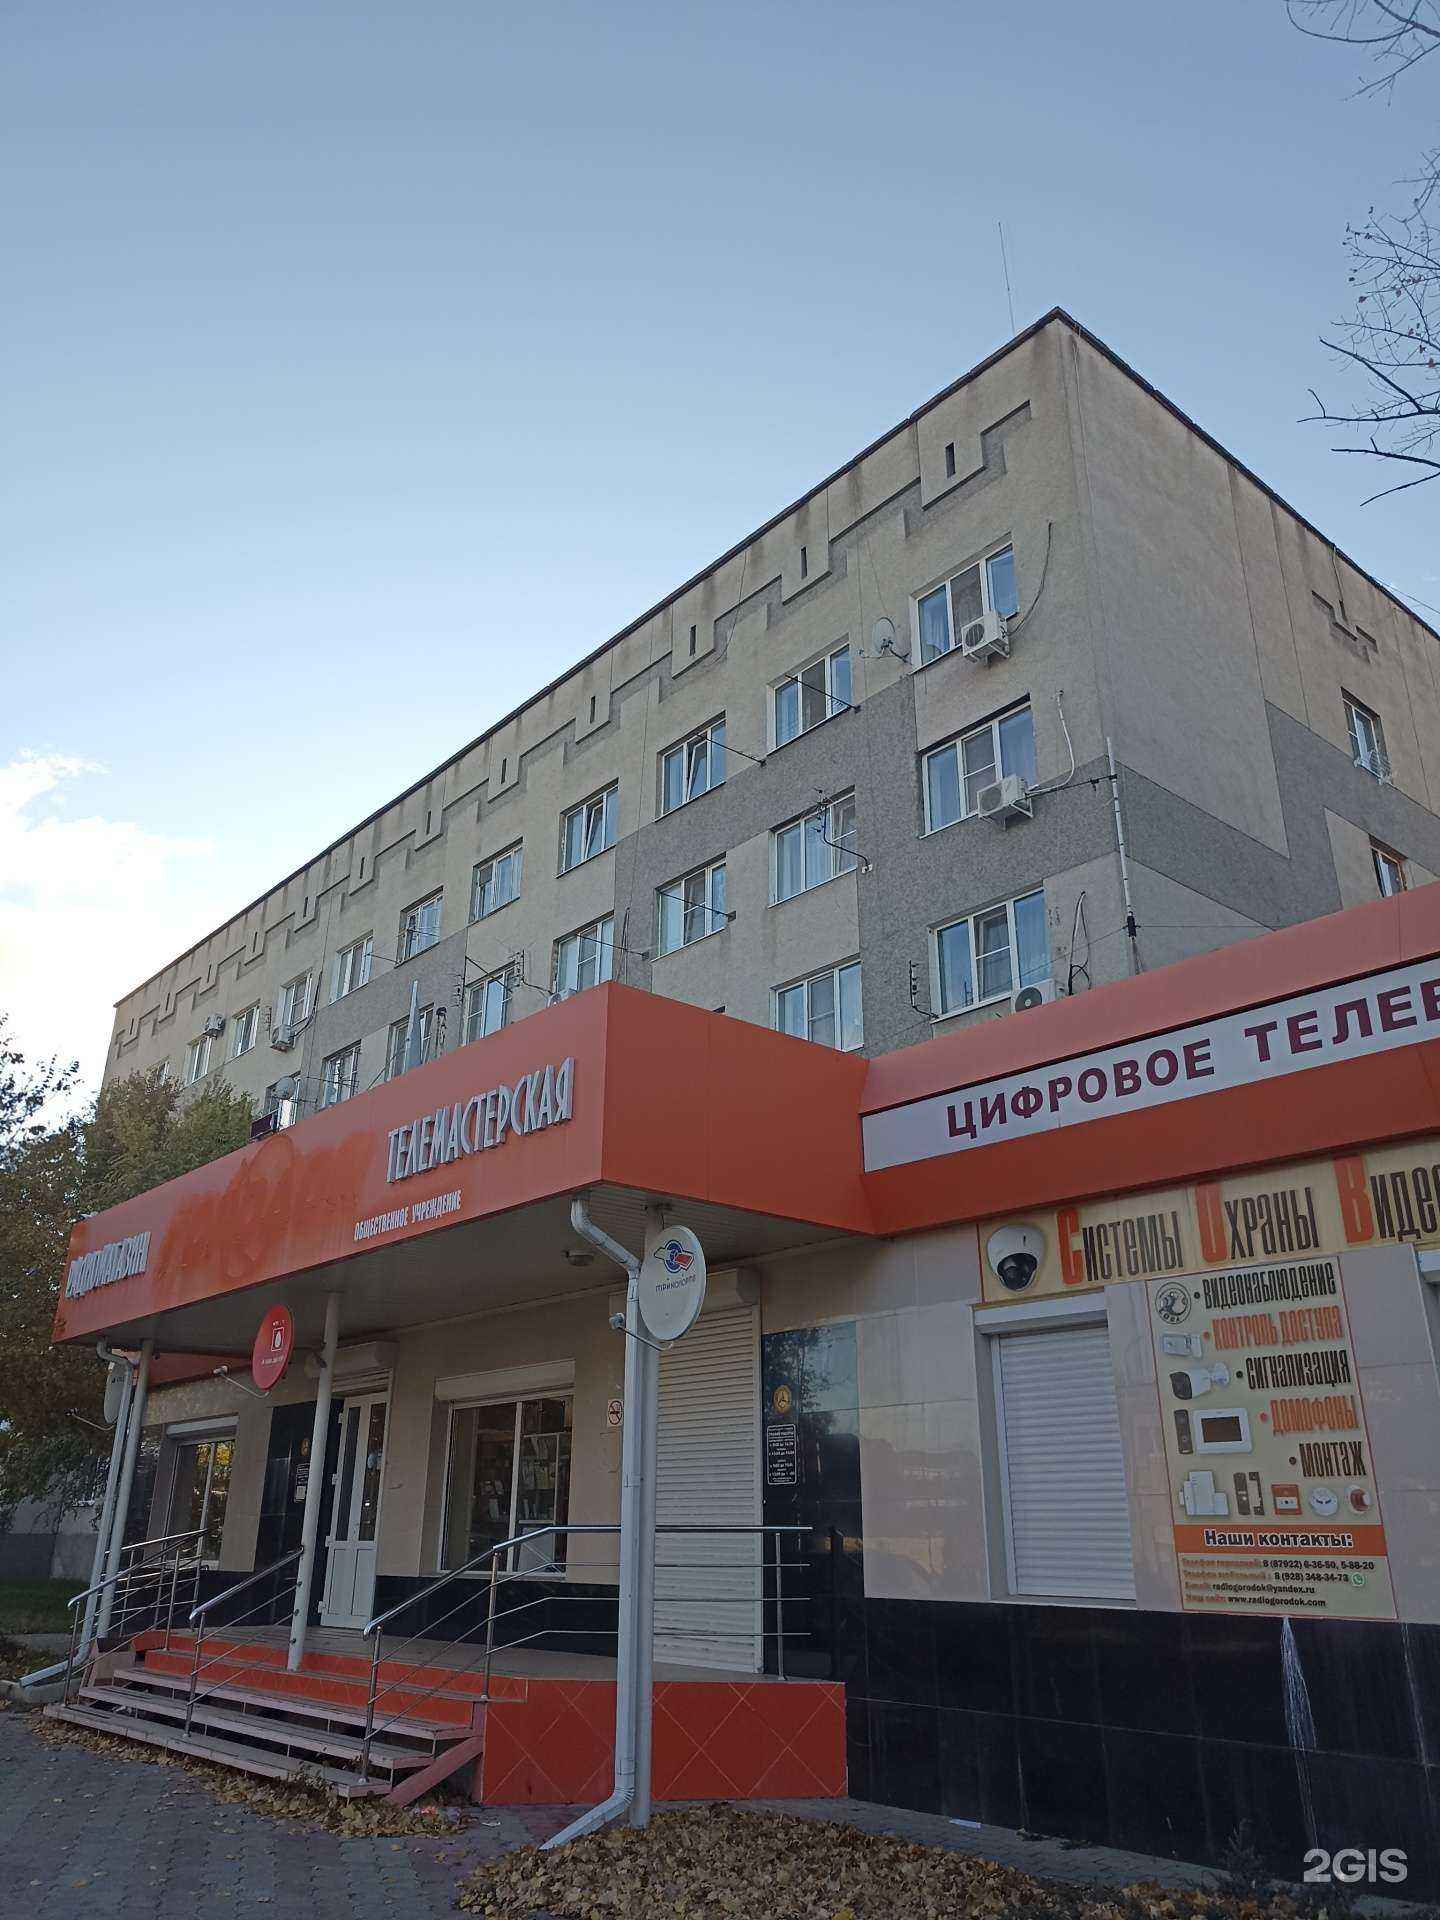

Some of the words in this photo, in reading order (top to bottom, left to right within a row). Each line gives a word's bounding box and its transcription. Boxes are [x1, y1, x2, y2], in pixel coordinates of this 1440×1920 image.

[946, 1038, 1215, 1140] ЦИФРОВОЕ
[386, 1056, 575, 1183] ТЕЛЕМАСТЕРСКАЯ
[354, 1206, 409, 1241] ОБЩЕСТВЕННОЕ
[411, 1189, 462, 1224] УЧРЕЖДЕНИЕ
[1204, 1529, 1254, 1547] Наши
[1258, 1531, 1353, 1547] контакты:
[1212, 1582, 1315, 1594] radiogorodok@yandex.ru
[1228, 1595, 1326, 1608] www.radiogorodok.com
